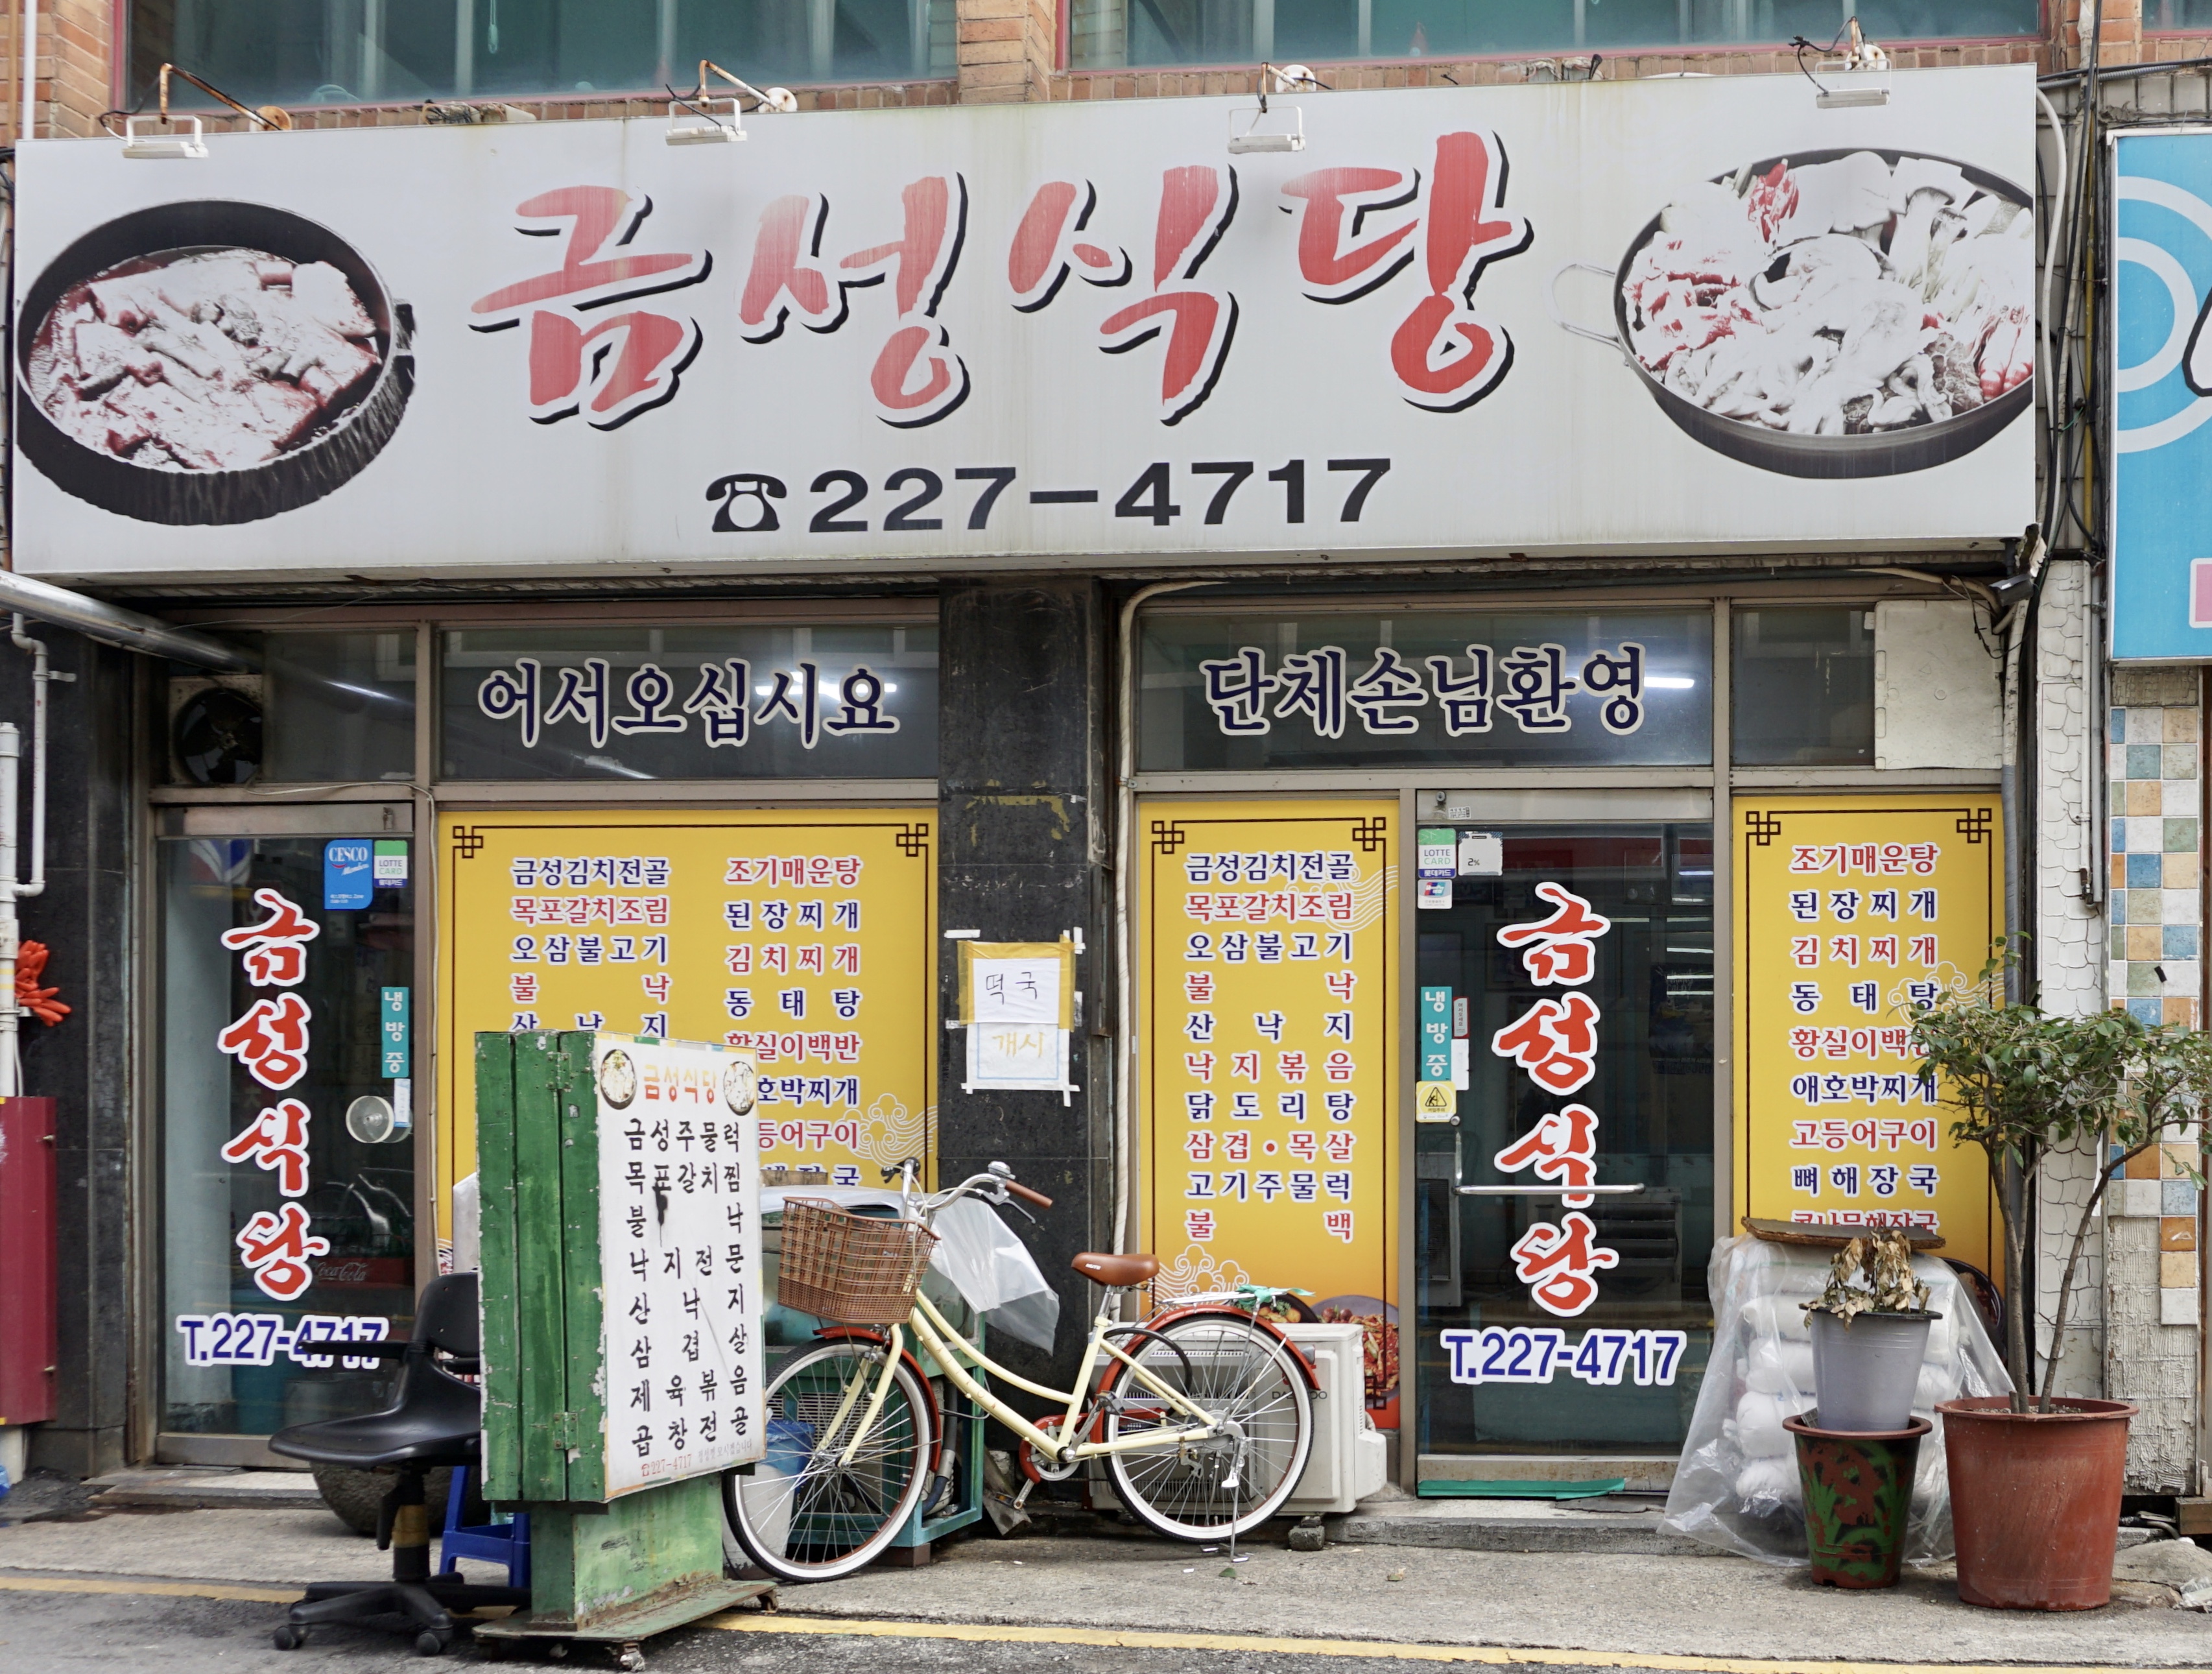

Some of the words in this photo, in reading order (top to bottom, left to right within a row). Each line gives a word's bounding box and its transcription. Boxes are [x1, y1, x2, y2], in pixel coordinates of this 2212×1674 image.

[468, 130, 1534, 431] 금성식당
[479, 658, 900, 748] 어서오십시요
[329, 847, 368, 862] CESCO
[1187, 854, 1354, 881] 금성김치전골
[1792, 844, 1939, 875] 조기매운탕
[512, 858, 669, 887] 금성김치전골
[726, 858, 861, 886] 조기매운탕
[512, 897, 669, 926] 목포갈치조림
[726, 902, 860, 930] 된장찌개
[1187, 893, 1353, 921] 목포갈치조림
[1792, 891, 1937, 920] 된장찌개
[512, 936, 667, 964] 오삼불고기
[726, 946, 860, 974] 김치찌개
[1187, 934, 1351, 961] 오삼불고기
[1792, 937, 1937, 966] 김치찌개
[385, 992, 406, 1074] 냉방중
[992, 1031, 1044, 1058] 개시
[1425, 991, 1449, 1077] 냉방중
[1187, 1053, 1353, 1081] 낙지볶음
[218, 888, 330, 1301] 금성식당
[644, 1064, 717, 1104] 금성식당
[757, 1076, 860, 1105] 호박찌개
[1793, 1075, 1936, 1103] 애호박찌개
[1187, 1094, 1353, 1121] 닭도리탕
[1492, 882, 1619, 1317] 금성식당
[624, 1118, 739, 1153] 금성주물럭
[757, 1120, 859, 1149] 등어구이
[1792, 1121, 1937, 1151] 고등어구이
[625, 1162, 740, 1194] 목포갈치찜
[1187, 1173, 1351, 1201] 고기주물럭
[1442, 1328, 1685, 1384] T.227-4717
[1272, 1391, 1327, 1400] DAEOO
[651, 1453, 692, 1475] 227-4717
